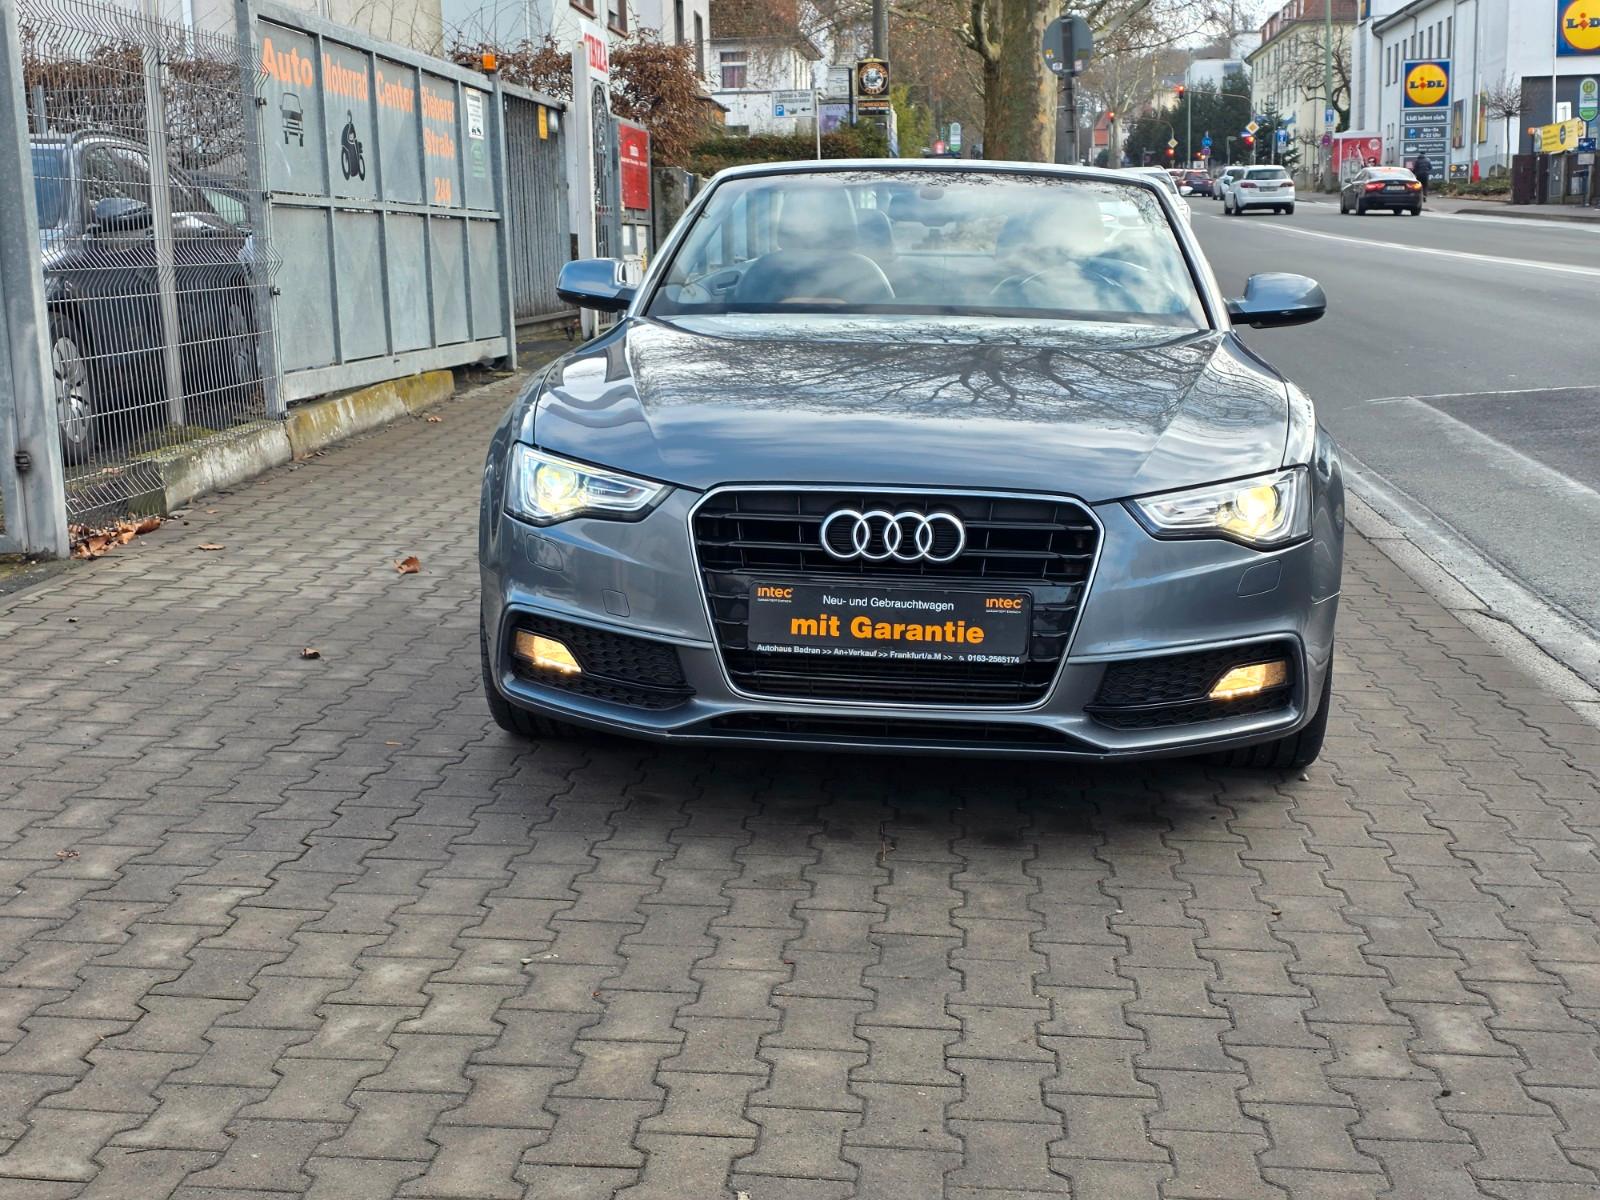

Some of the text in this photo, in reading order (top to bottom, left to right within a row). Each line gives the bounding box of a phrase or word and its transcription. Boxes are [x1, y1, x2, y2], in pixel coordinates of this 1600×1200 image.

[1566, 12, 1600, 31] LID
[262, 37, 313, 88] Auto
[322, 53, 368, 101] Motorrad
[376, 71, 414, 112] Center
[757, 587, 793, 598] intec
[823, 595, 954, 612] Neu- und Gebrauchtwagen
[986, 597, 1023, 609] intec
[790, 613, 985, 644] mit Garantie
[757, 644, 792, 653] Autohaus
[793, 646, 820, 654] Badran
[833, 648, 877, 657] An+Verkauf
